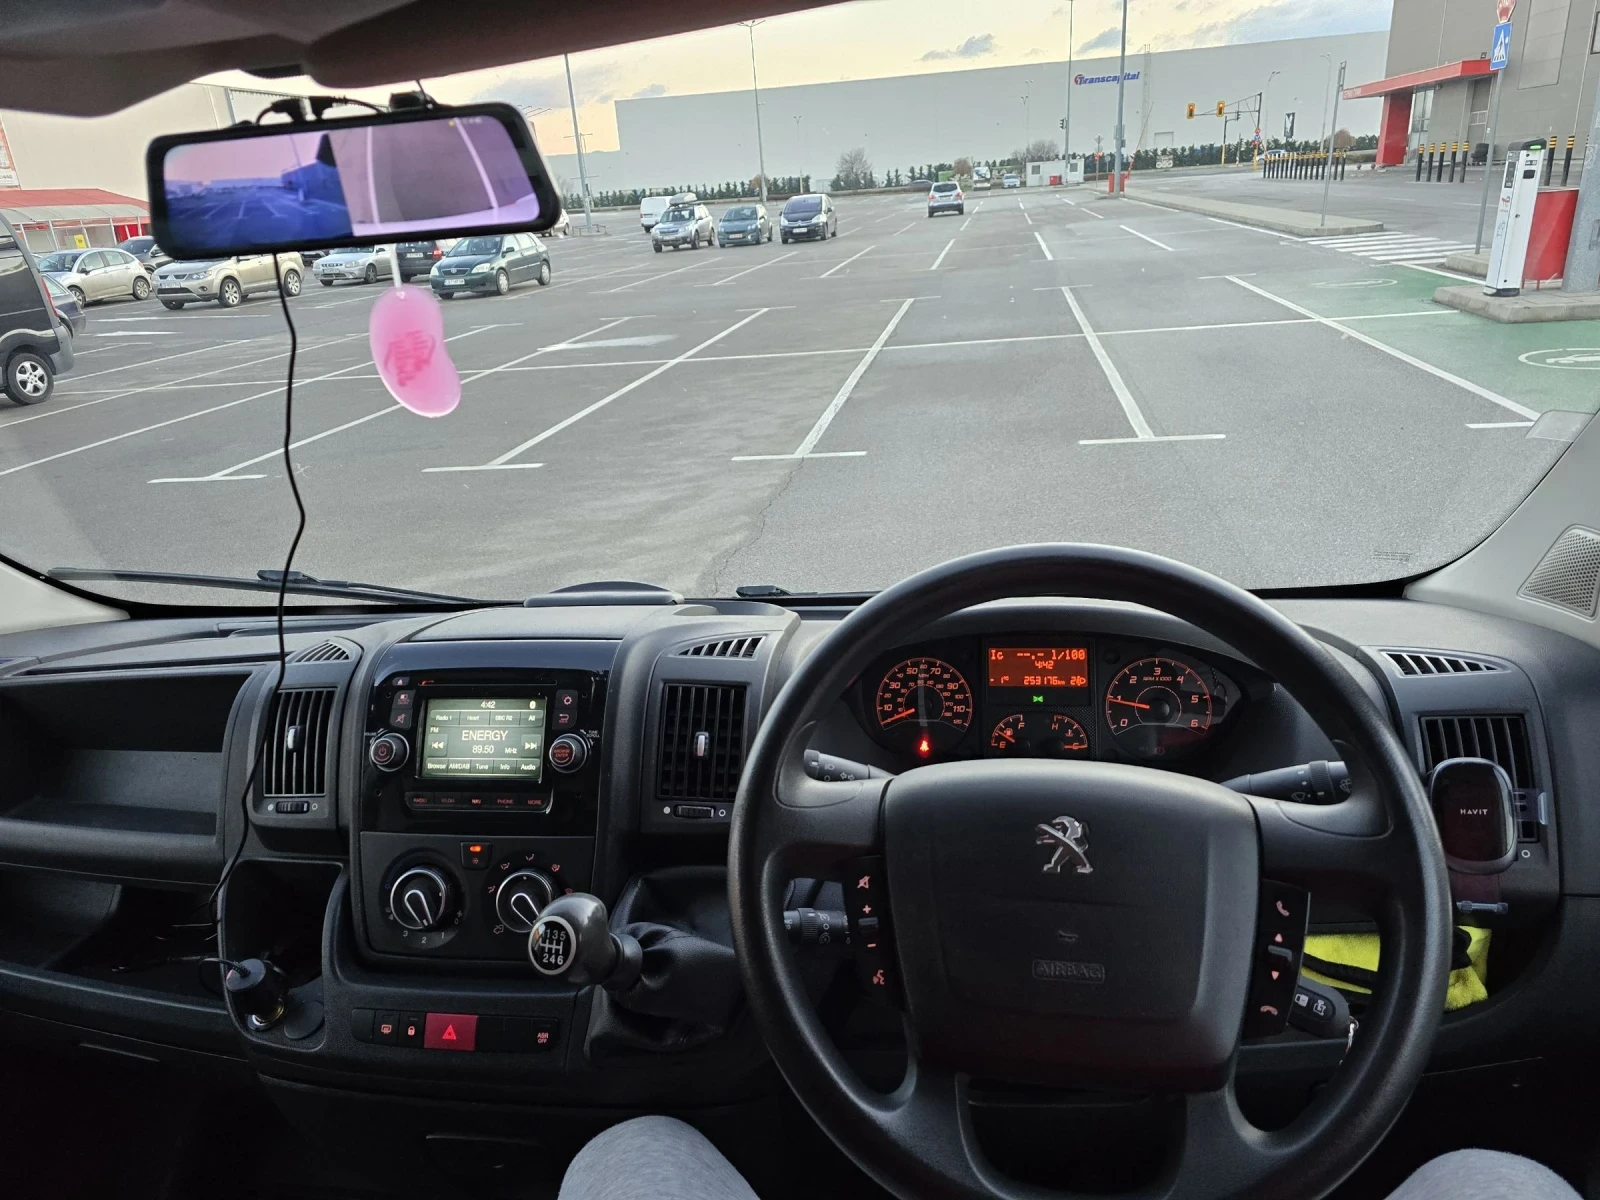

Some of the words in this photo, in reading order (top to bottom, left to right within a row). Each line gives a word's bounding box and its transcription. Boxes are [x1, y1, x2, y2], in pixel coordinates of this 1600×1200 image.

[1035, 661, 1054, 669] 4:42
[1130, 676, 1137, 684] 2
[1177, 676, 1184, 684] 4
[1191, 695, 1199, 703] 5
[462, 730, 508, 741] ENERGY
[472, 745, 494, 753] 89.50
[1036, 962, 1102, 978] AIRBAG
